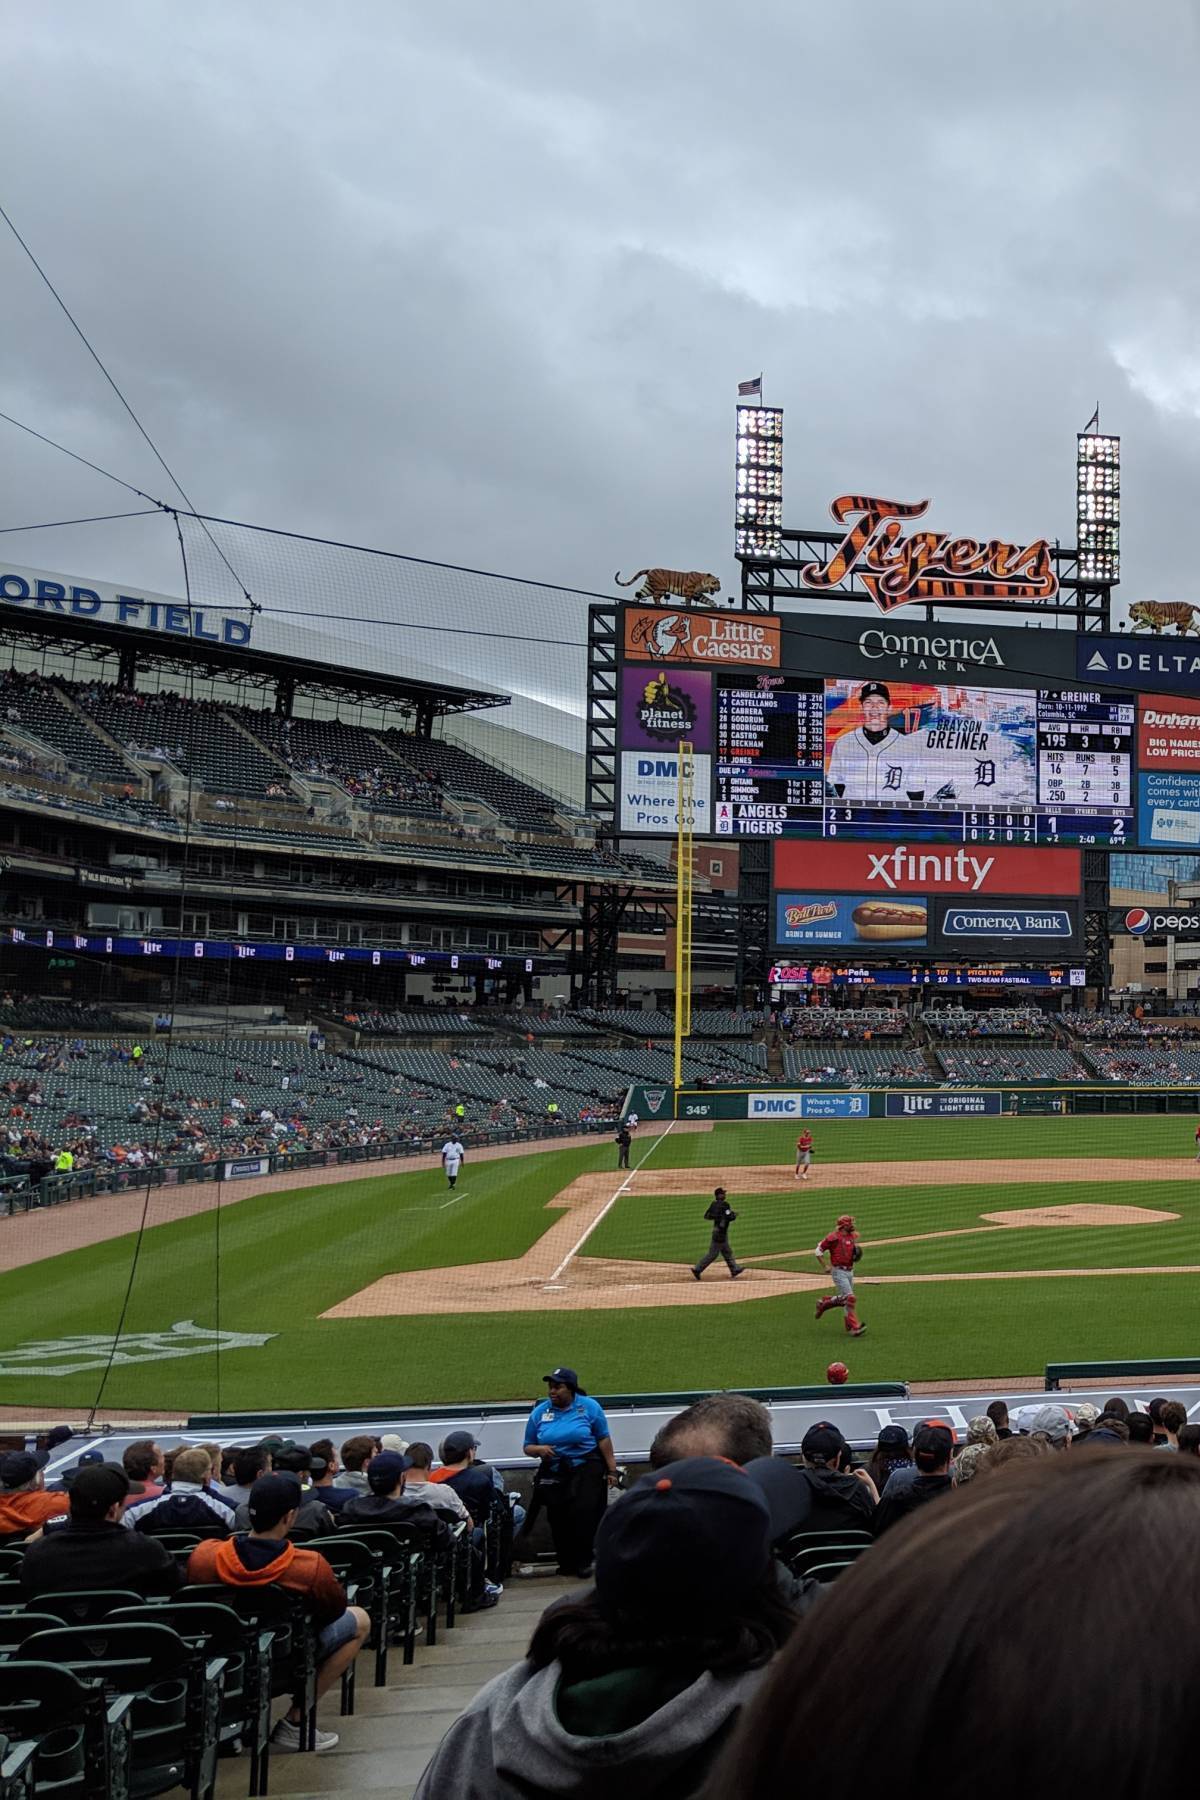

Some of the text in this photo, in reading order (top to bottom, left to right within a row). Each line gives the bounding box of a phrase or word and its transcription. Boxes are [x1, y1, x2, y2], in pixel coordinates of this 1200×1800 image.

[800, 493, 1060, 616] Tigers
[0, 574, 252, 645] ORD FIELD
[709, 619, 765, 642] Little
[693, 636, 774, 661] Caesars
[900, 658, 967, 672] PARK
[731, 691, 773, 699] CANDELARIO
[1040, 690, 1100, 703] 17 GREINER
[731, 699, 778, 707] CASTELLANOS
[641, 708, 683, 720] planet
[731, 707, 763, 715] CABRERA
[1038, 711, 1067, 719] Columbia,
[646, 718, 692, 729] fitness
[731, 715, 764, 723] GOODRUM
[903, 708, 921, 733] 17
[937, 718, 982, 733] GRAYSON
[731, 740, 764, 748] BECKHAM
[927, 731, 988, 751] GREINER
[1041, 734, 1120, 749] .195 3 9
[1149, 738, 1166, 747] BIG
[731, 748, 760, 756] GREINER
[1048, 753, 1120, 763] HITS RUNS BB
[1147, 748, 1168, 757] LOW
[638, 760, 695, 777] DMC
[1051, 763, 1118, 776] 16 7 5
[1048, 779, 1063, 787] OBP
[1046, 791, 1119, 803] .250 2 0
[1147, 787, 1180, 797] comes
[627, 794, 675, 807] Where
[1147, 798, 1175, 808] every
[637, 812, 669, 824] Pros
[738, 805, 787, 818] ANGELS
[830, 809, 1029, 826] 2 3 5 5 0 0
[738, 821, 783, 834] TIGERS
[830, 824, 1030, 841] 0 0 2 0 2
[1048, 817, 1124, 835] 1 2
[866, 845, 995, 890] xfinity
[1024, 915, 1062, 930] Bank
[143, 941, 162, 955] Lite
[238, 945, 256, 958] Lite
[328, 951, 346, 962] Lite
[410, 954, 426, 966] Lite
[488, 957, 503, 969] Lite
[686, 1105, 711, 1115] 345'
[753, 1100, 796, 1112] DMC
[902, 1096, 932, 1114] Lite
